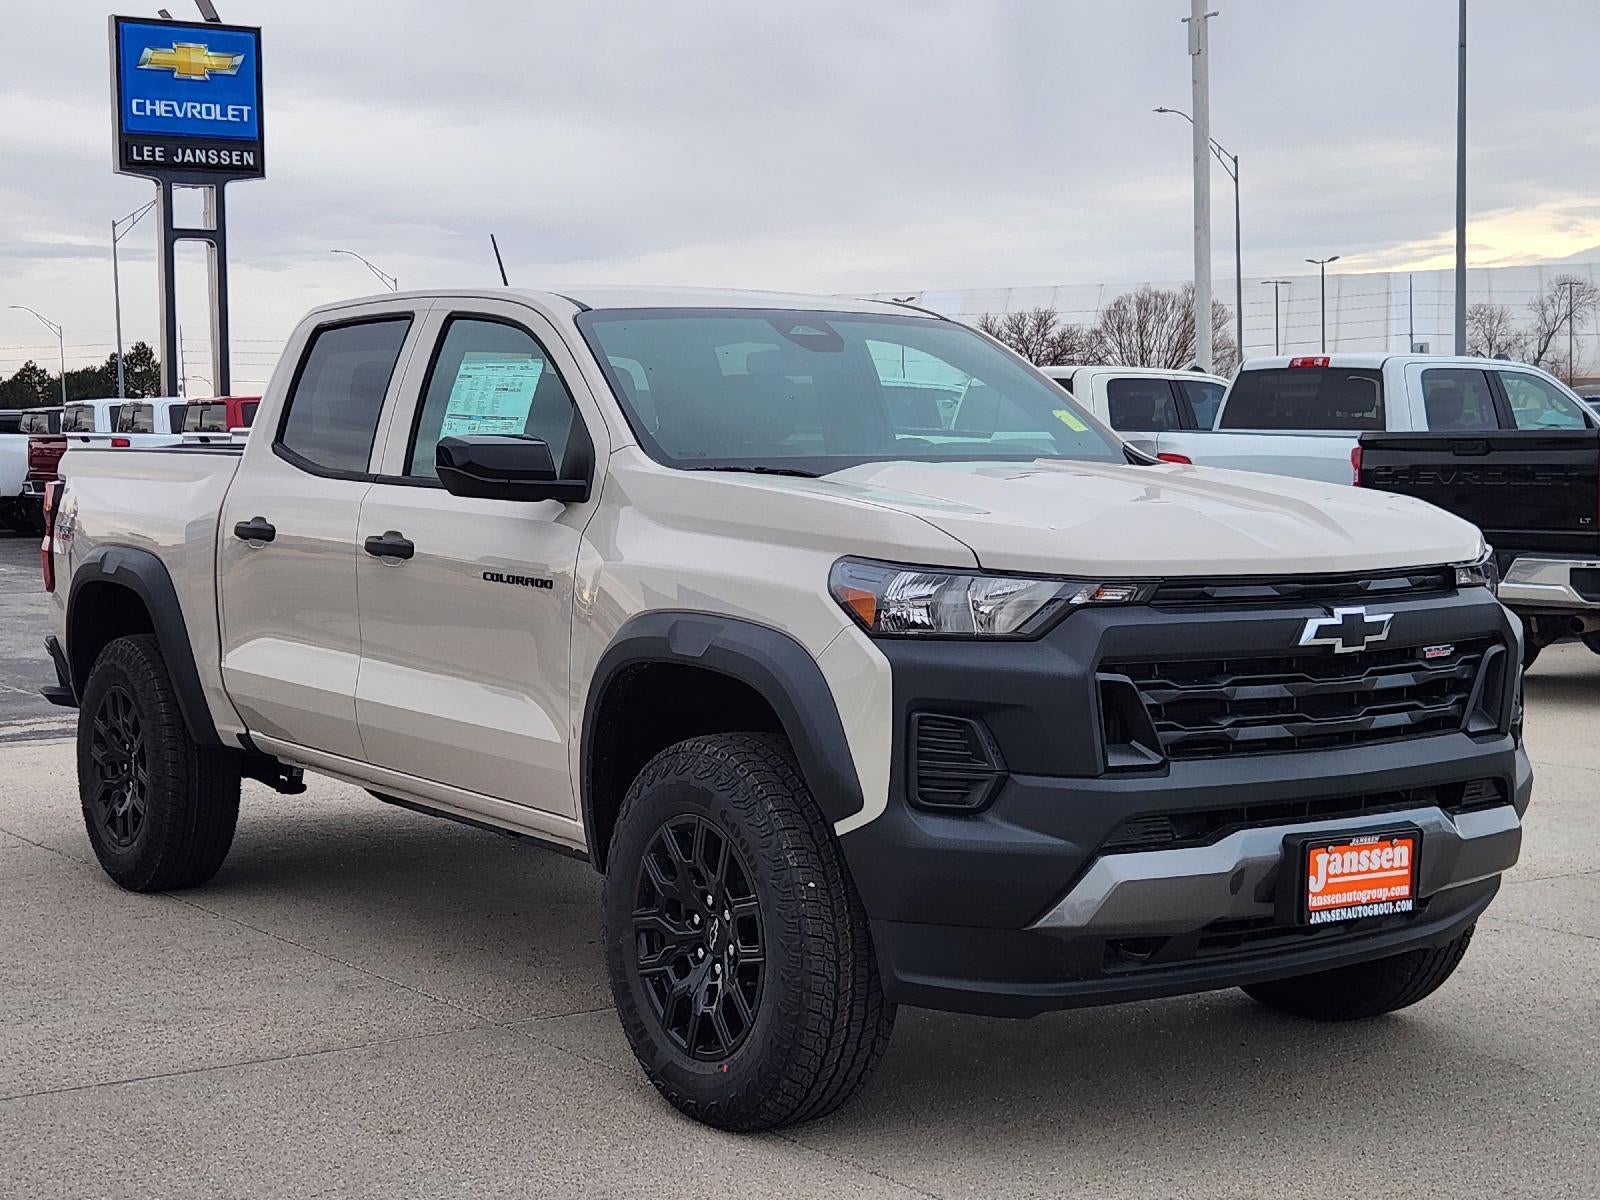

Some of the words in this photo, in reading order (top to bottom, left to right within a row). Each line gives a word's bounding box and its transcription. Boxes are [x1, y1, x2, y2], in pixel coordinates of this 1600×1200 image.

[131, 98, 252, 122] CHEVROLET
[132, 145, 165, 162] LEE
[173, 148, 254, 166] JANSSEN
[1374, 465, 1580, 486] CHEVROLET
[482, 571, 554, 590] COLORADO
[1308, 844, 1410, 893] Janssen
